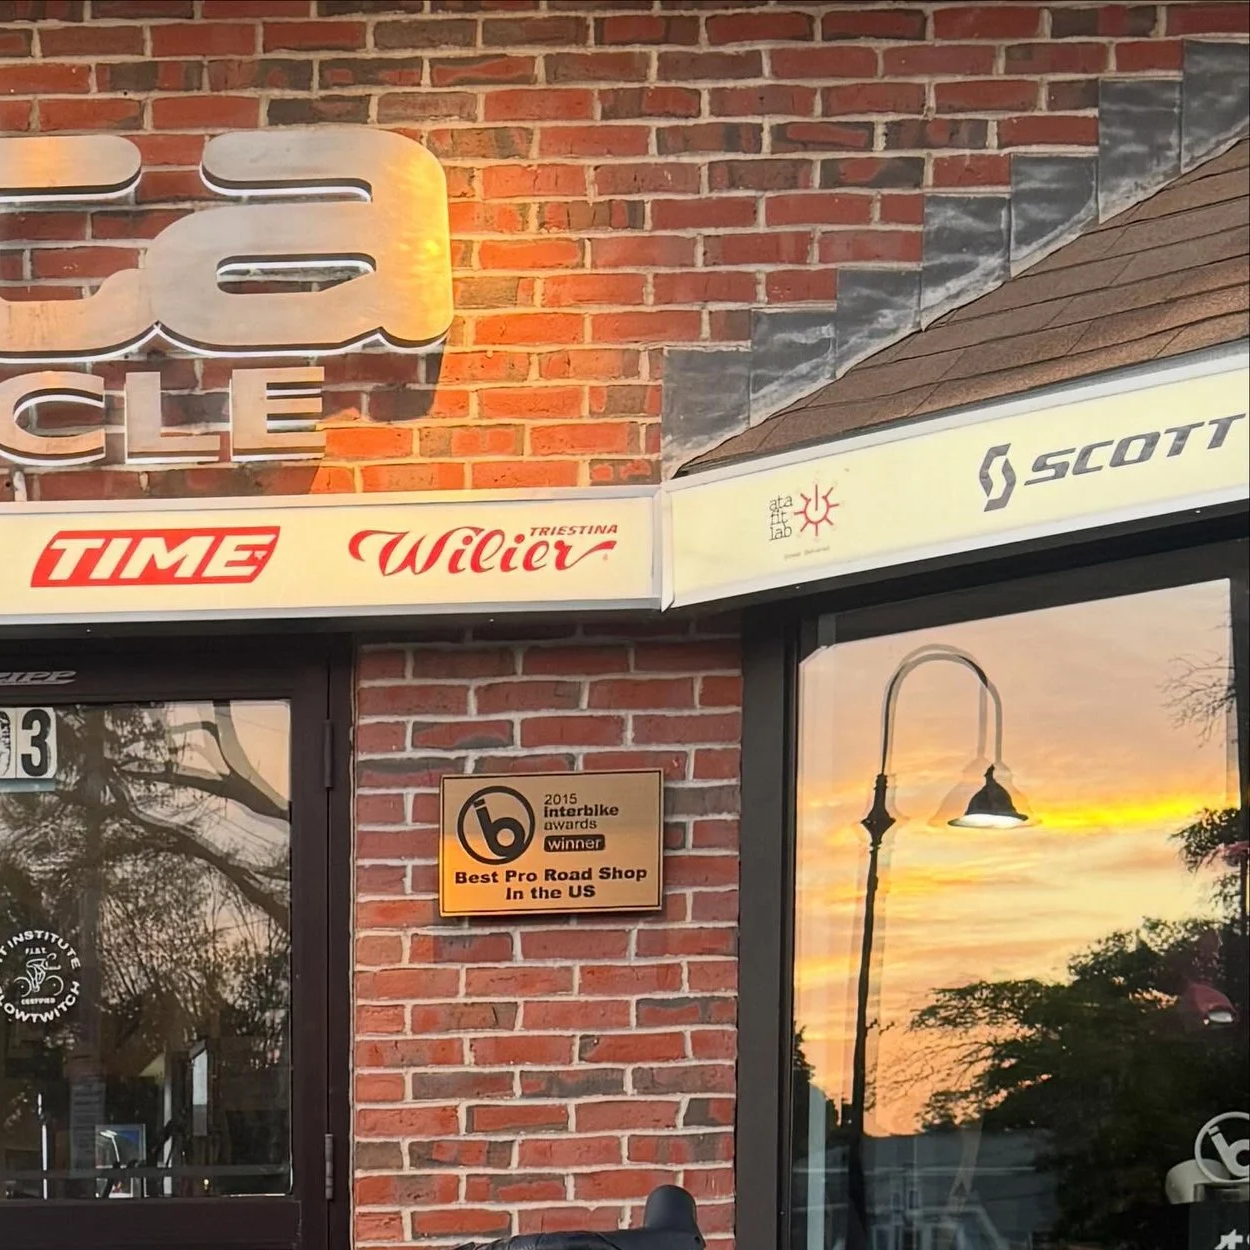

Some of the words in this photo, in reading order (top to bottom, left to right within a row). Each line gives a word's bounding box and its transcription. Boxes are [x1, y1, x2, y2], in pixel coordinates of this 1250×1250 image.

[1024, 414, 1246, 486] SCOTT
[769, 494, 793, 512] ata
[770, 510, 789, 526] fit
[530, 524, 619, 537] TRIESTINA
[769, 525, 793, 541] lab
[48, 534, 277, 580] TIME
[349, 527, 617, 577] Wilier
[544, 793, 578, 805] 2015
[544, 804, 619, 818] interbike
[544, 818, 598, 831] awards
[547, 837, 602, 850] winner
[455, 870, 499, 885] Best
[505, 869, 537, 883] Pro
[544, 868, 592, 881] Road
[598, 866, 647, 881] Shop
[506, 887, 524, 900] In
[531, 886, 562, 899] the
[568, 885, 596, 898] US
[7, 930, 81, 970] INSTITUTE
